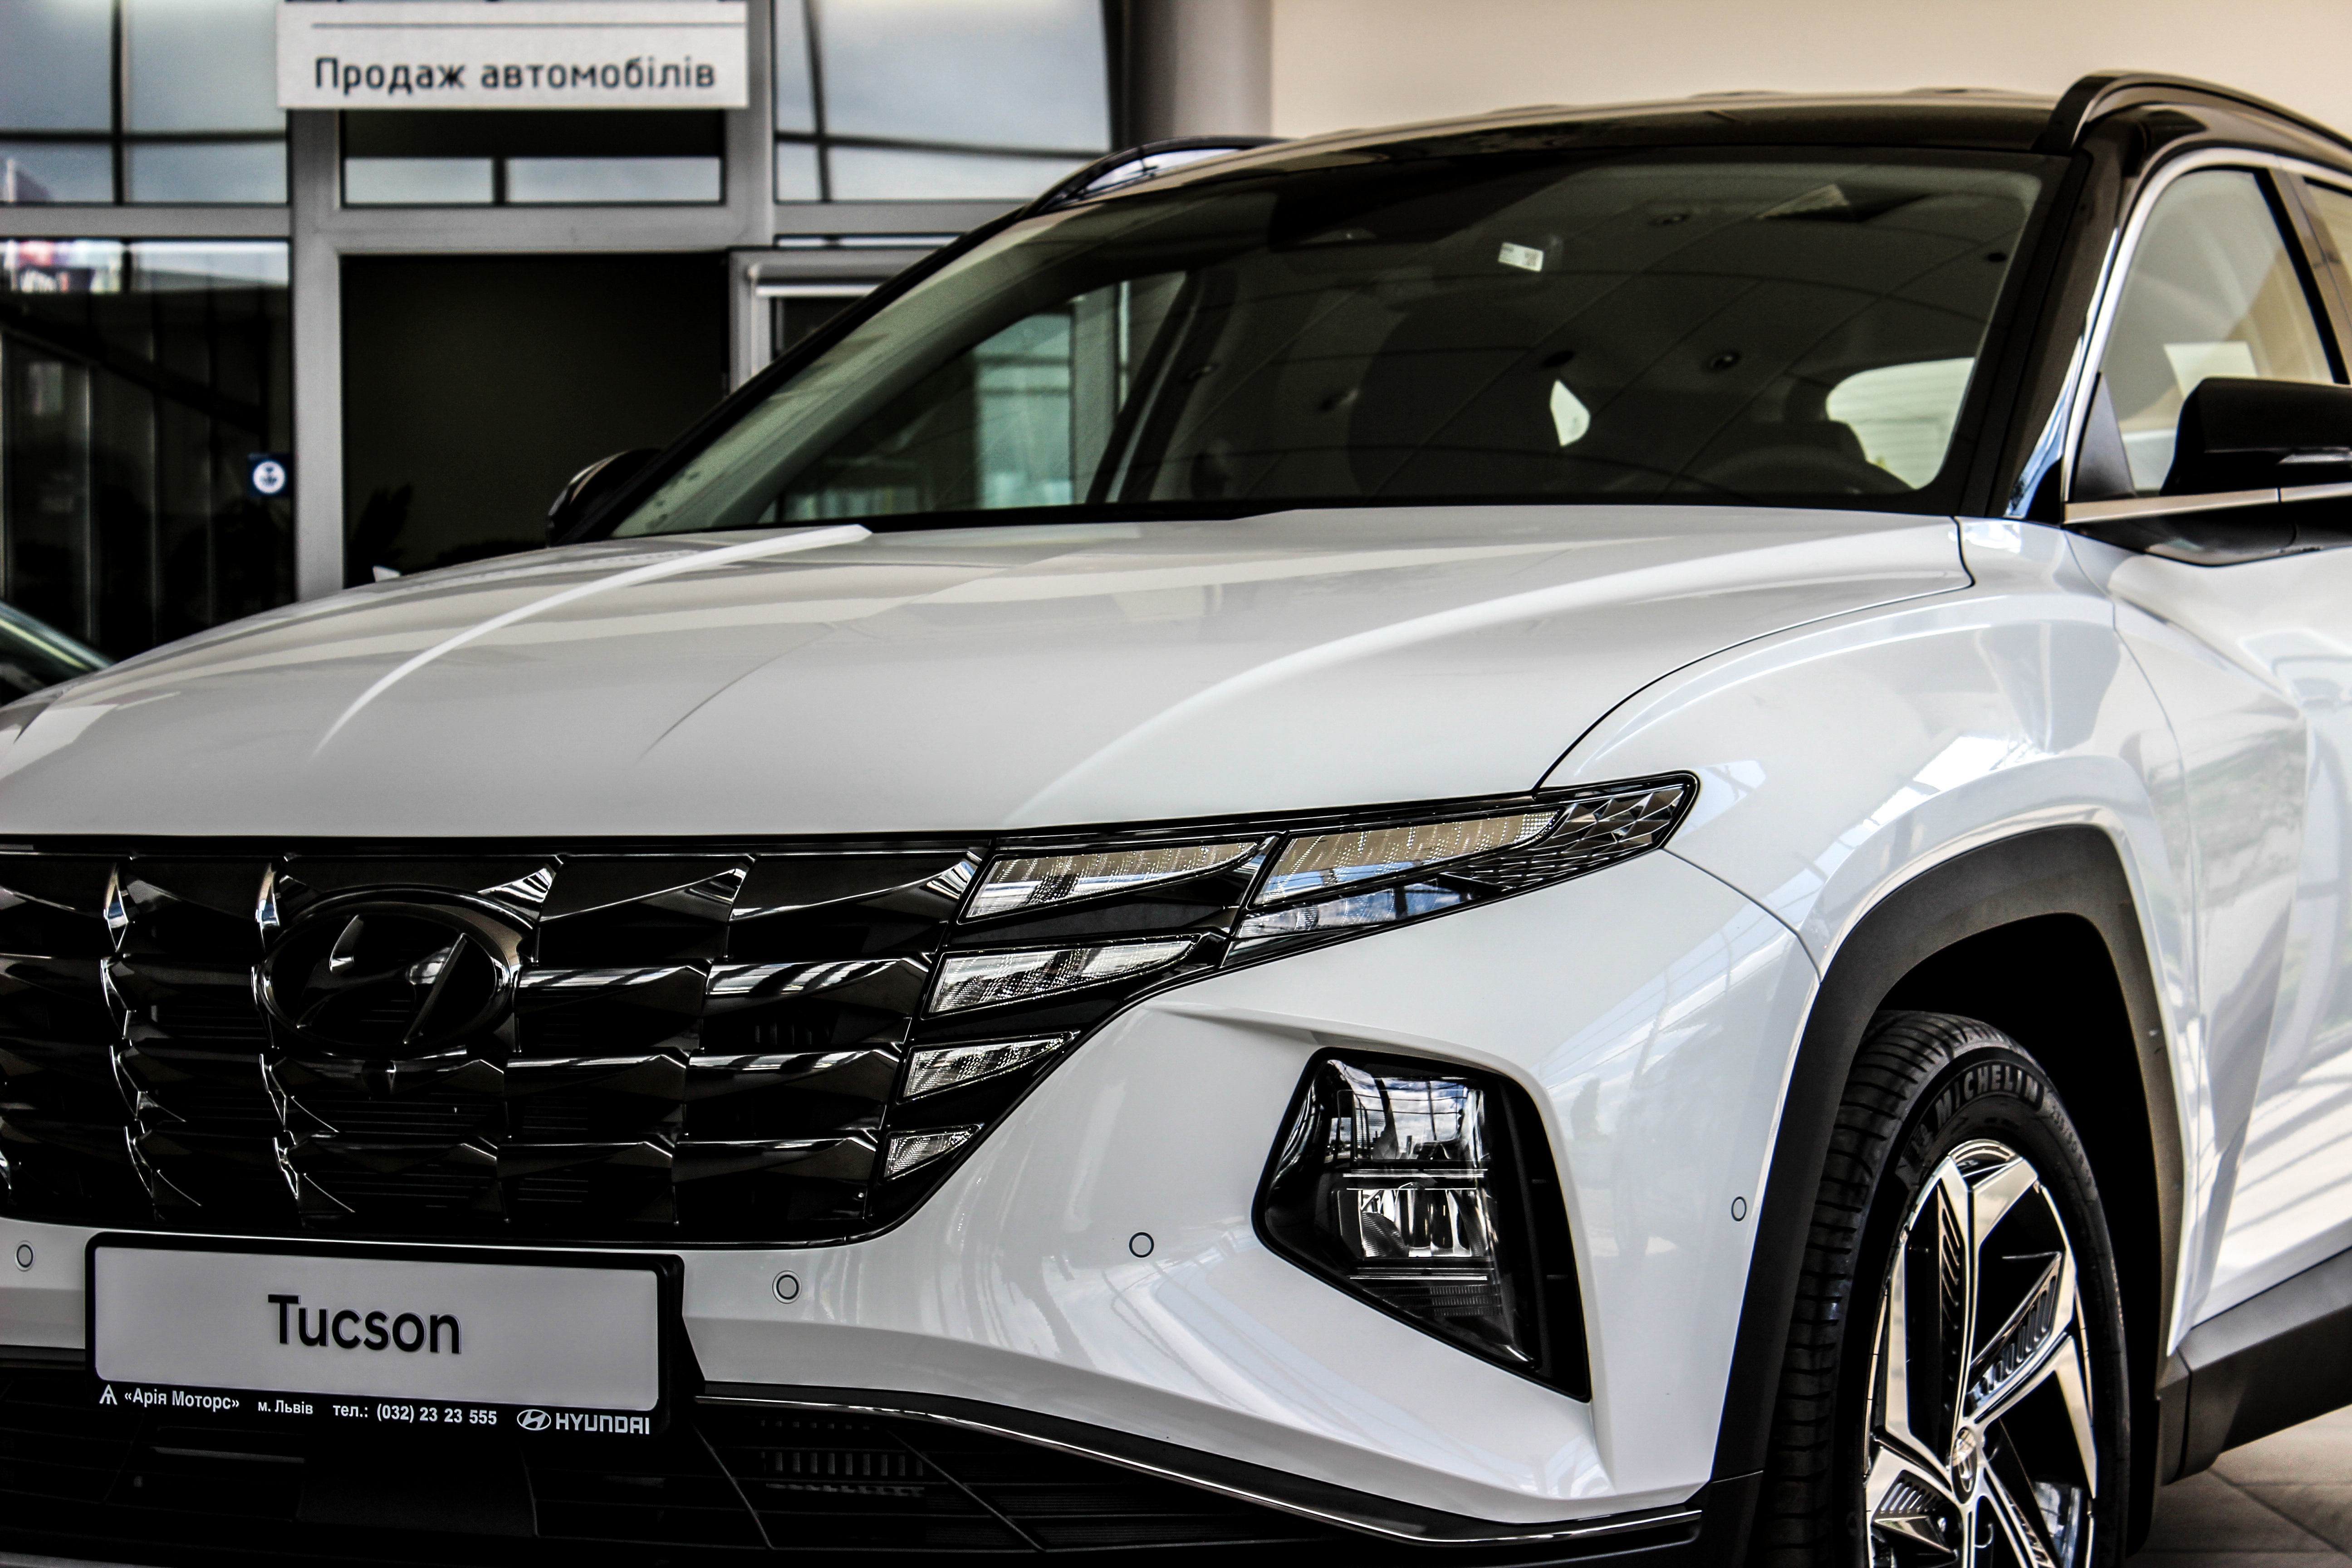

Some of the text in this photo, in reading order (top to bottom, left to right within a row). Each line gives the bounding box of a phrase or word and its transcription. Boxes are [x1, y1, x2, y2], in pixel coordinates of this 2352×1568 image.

[315, 56, 715, 96] Продаж автомобілів
[1935, 1064, 2038, 1132] MICHELIN
[267, 1293, 462, 1355] Tucson
[124, 1387, 497, 1426] «Арія Моторс» м. Львів тел.: (032) 23 23 555
[555, 1412, 650, 1435] HYUNDAI
